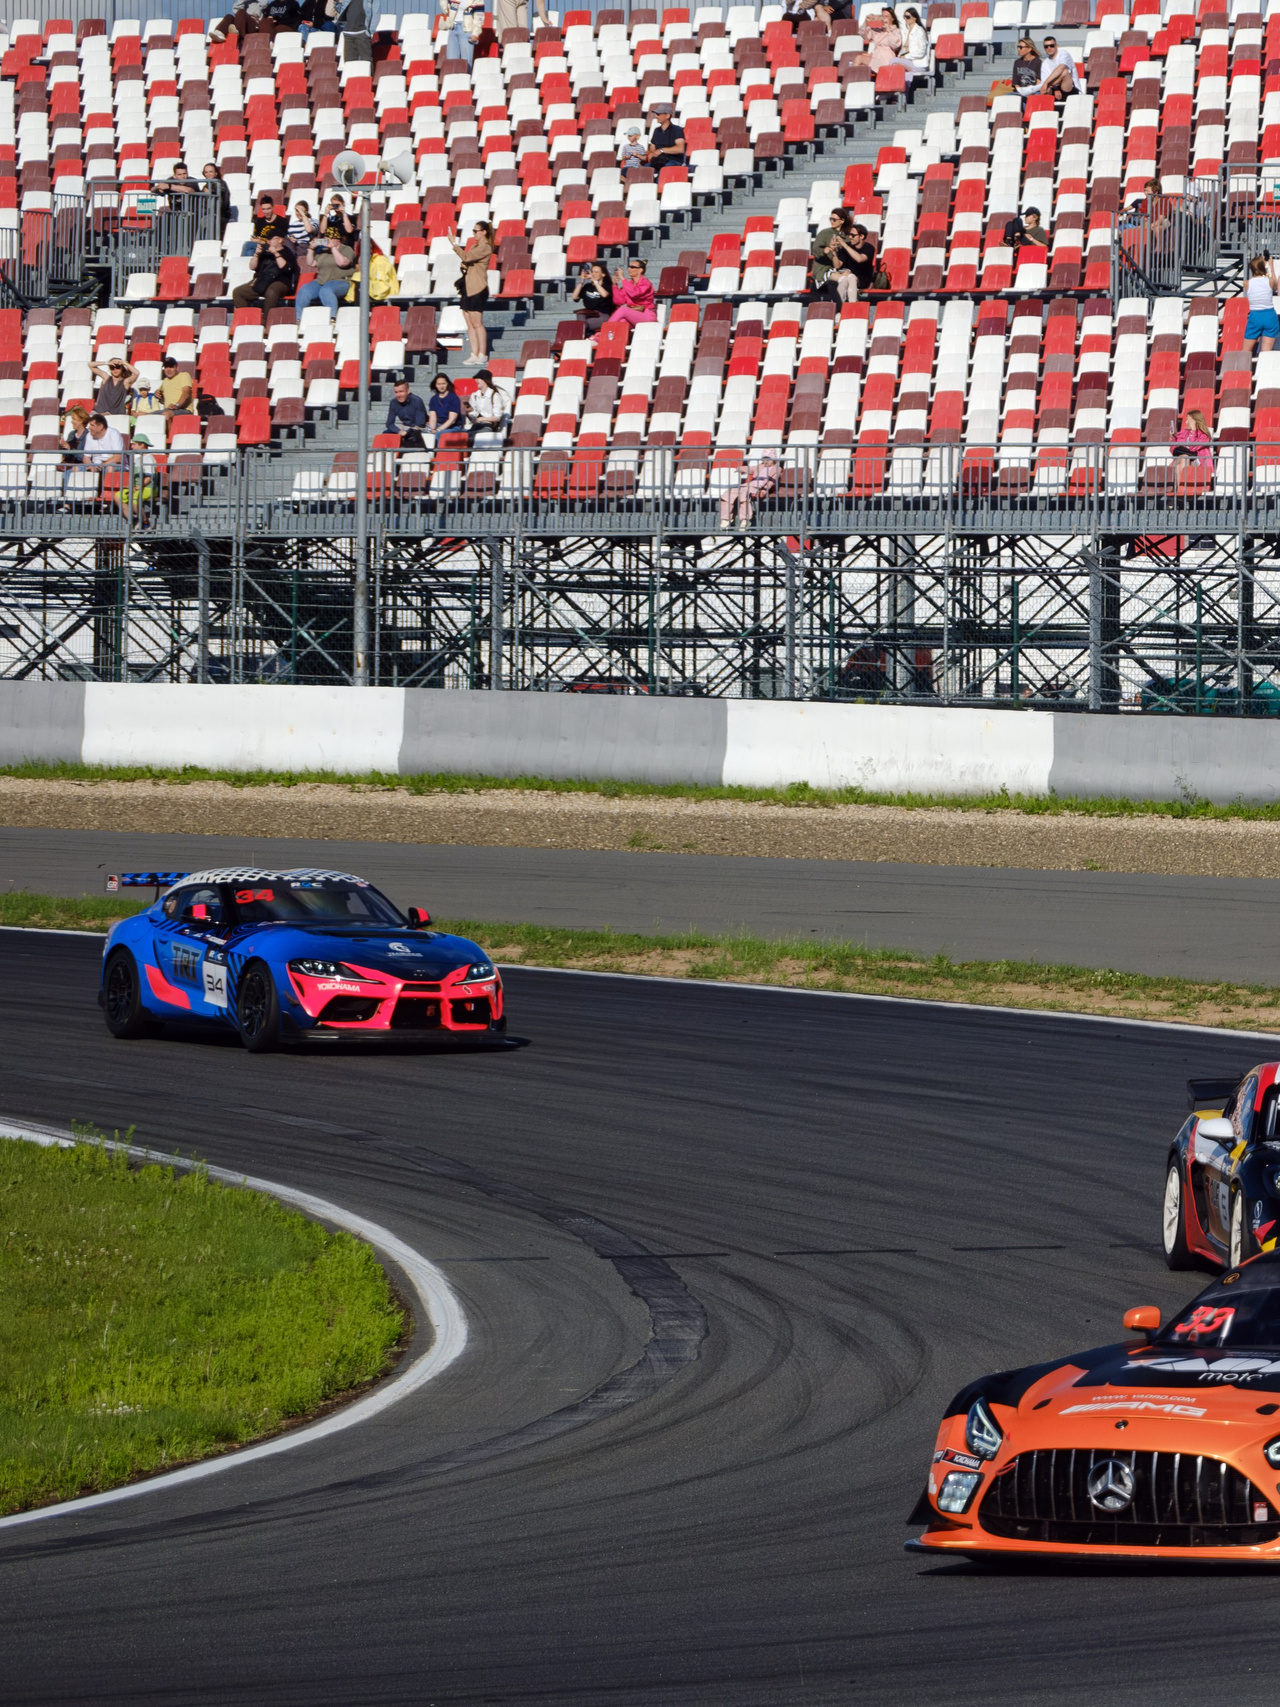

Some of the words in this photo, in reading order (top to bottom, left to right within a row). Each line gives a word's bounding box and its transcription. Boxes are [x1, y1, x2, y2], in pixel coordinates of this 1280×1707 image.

[235, 888, 275, 904] 34
[206, 973, 224, 995] 34
[317, 982, 361, 992] YOKOHAMA
[1175, 1305, 1236, 1333] 33
[1106, 1401, 1208, 1416] AMG
[953, 1454, 981, 1468] YOKOHAMA
